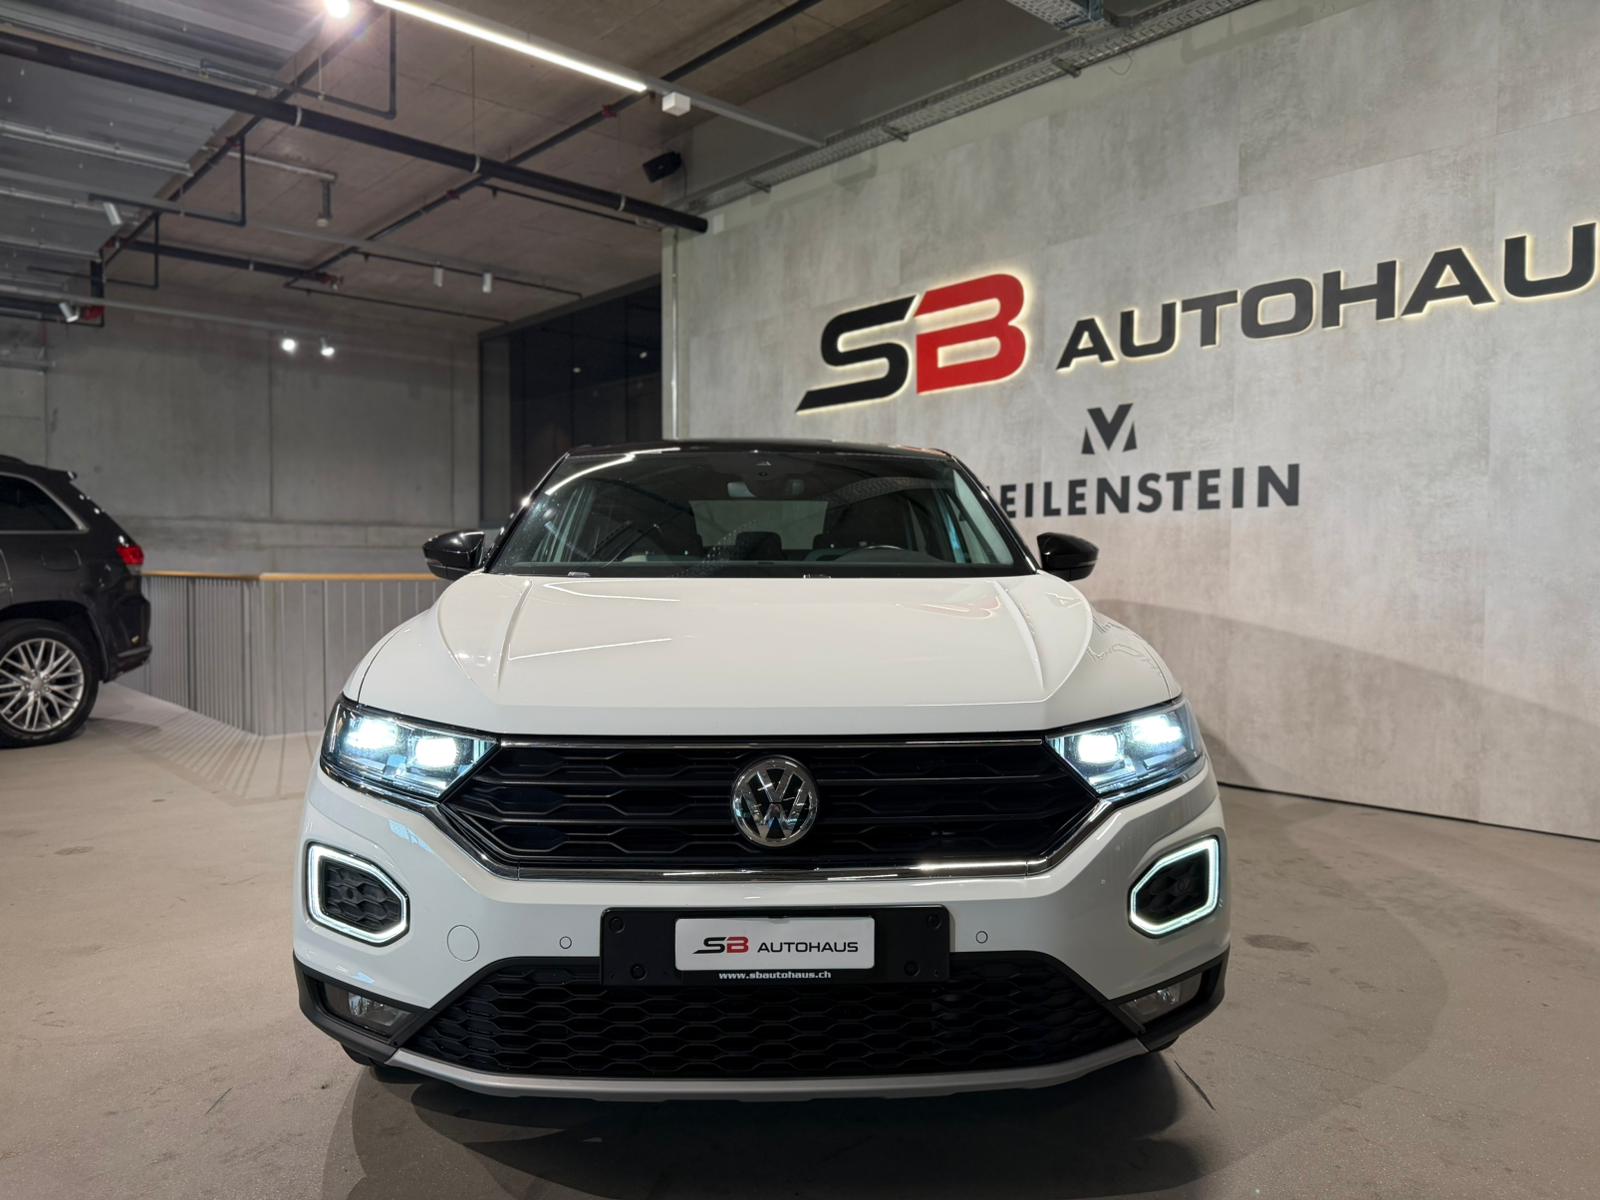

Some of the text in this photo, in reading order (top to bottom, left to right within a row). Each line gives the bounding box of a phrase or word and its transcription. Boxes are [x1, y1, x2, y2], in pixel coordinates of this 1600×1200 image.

[795, 222, 1596, 412] SB AUTOHAU
[985, 463, 1299, 518] EILENSTEIN
[692, 936, 859, 954] SB AUTOHAUS
[718, 970, 832, 980] www.sbautohaus.ch
